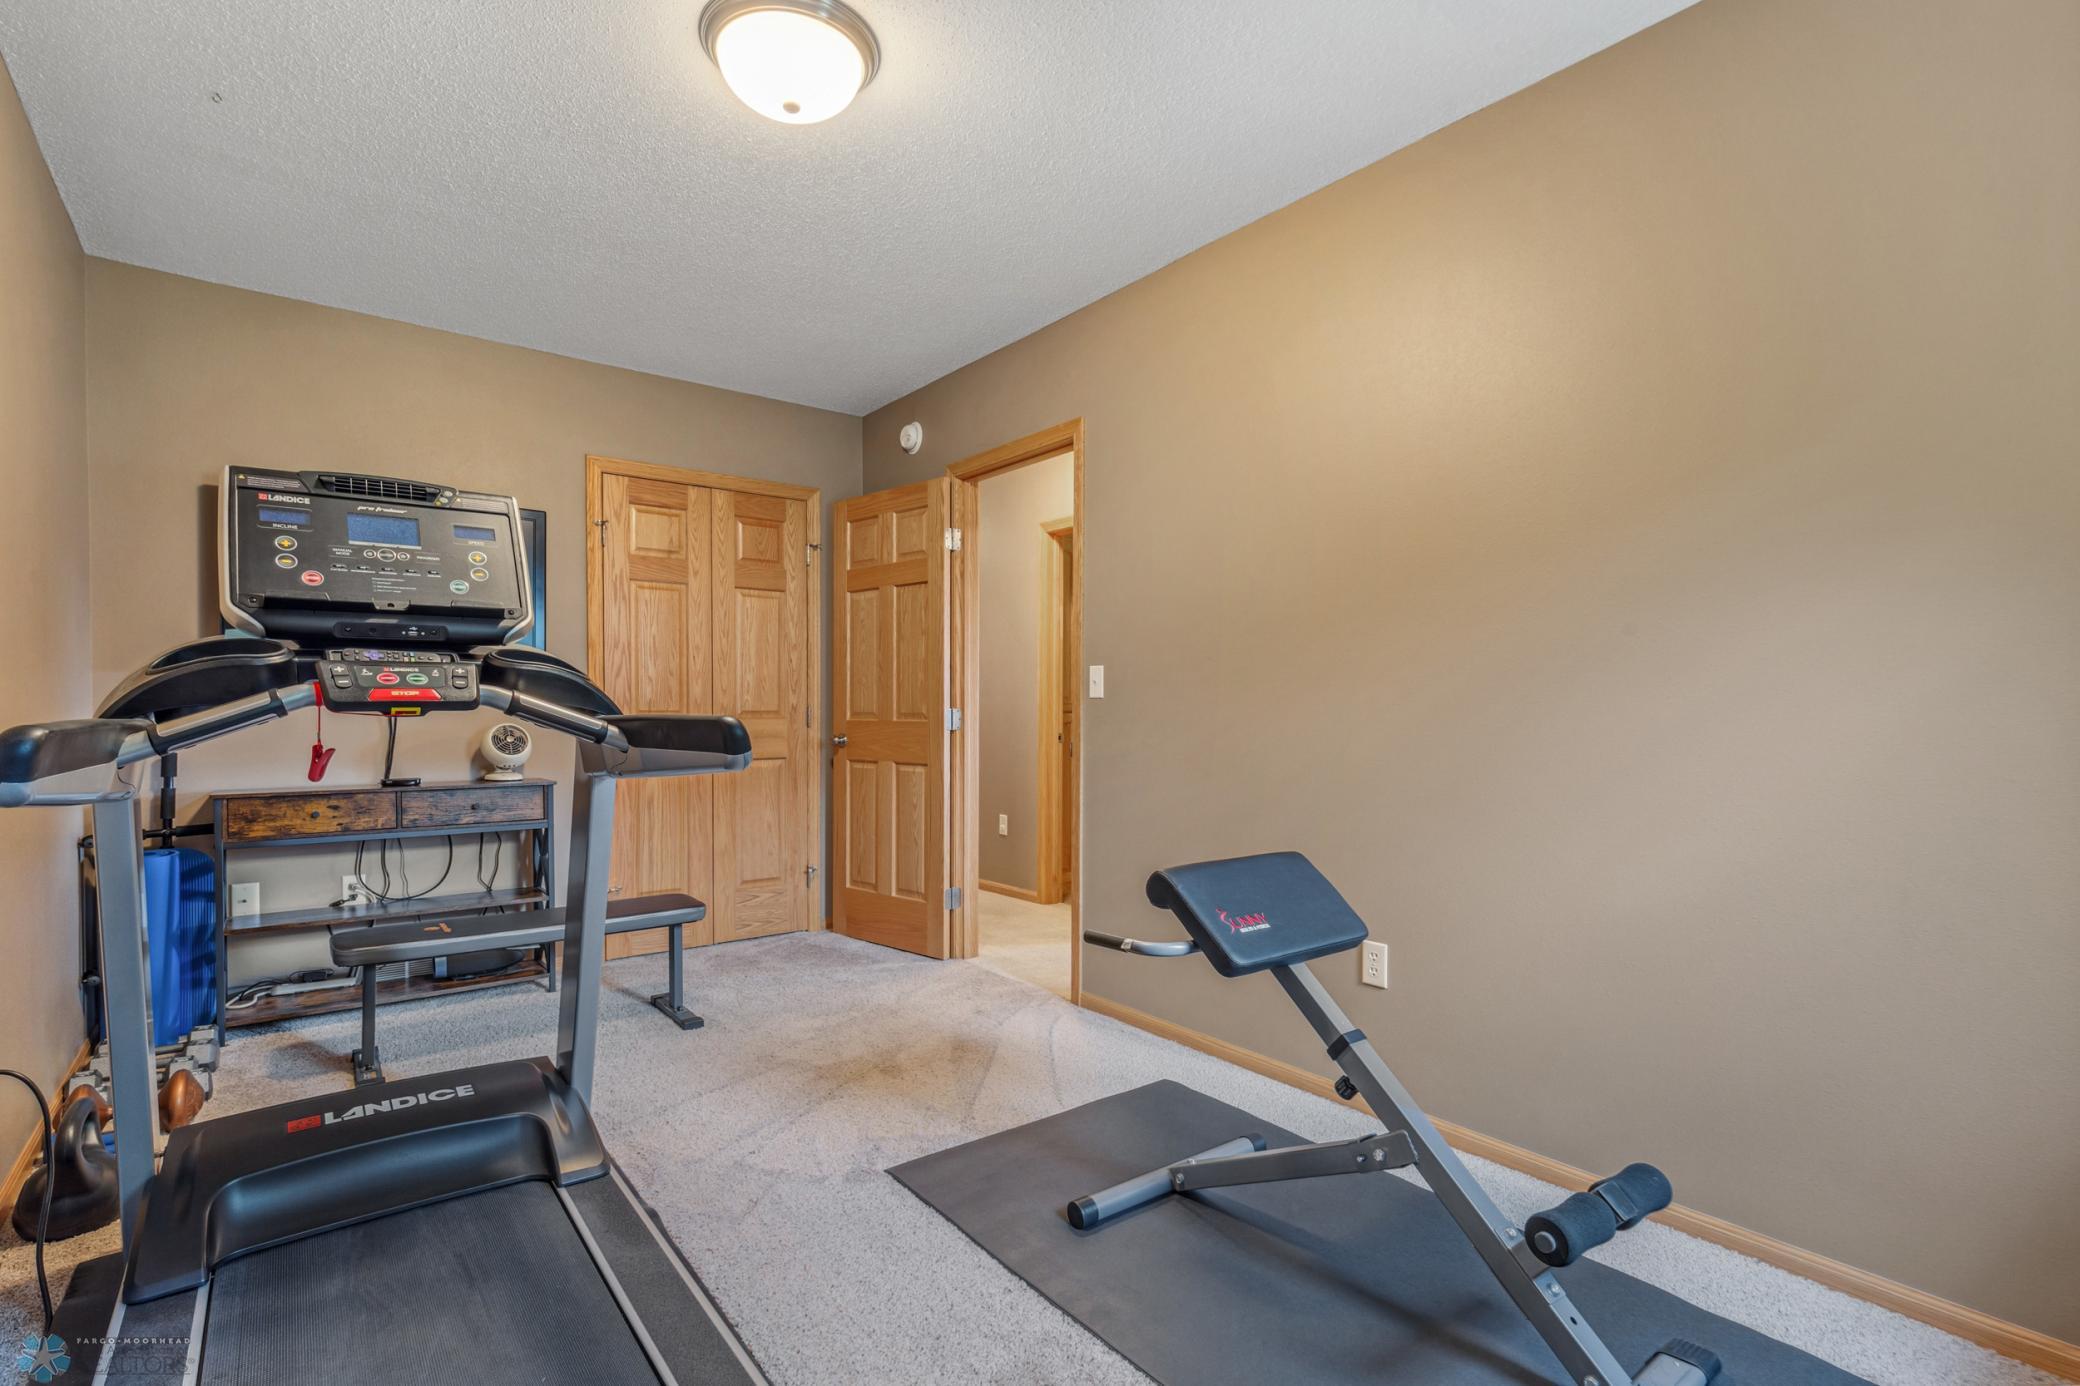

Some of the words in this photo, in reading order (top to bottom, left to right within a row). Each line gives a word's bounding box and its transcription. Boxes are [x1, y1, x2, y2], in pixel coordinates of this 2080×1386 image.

[268, 493, 310, 505] LANDICE
[272, 522, 298, 530] INCLINE
[324, 1084, 475, 1125] LANDICE
